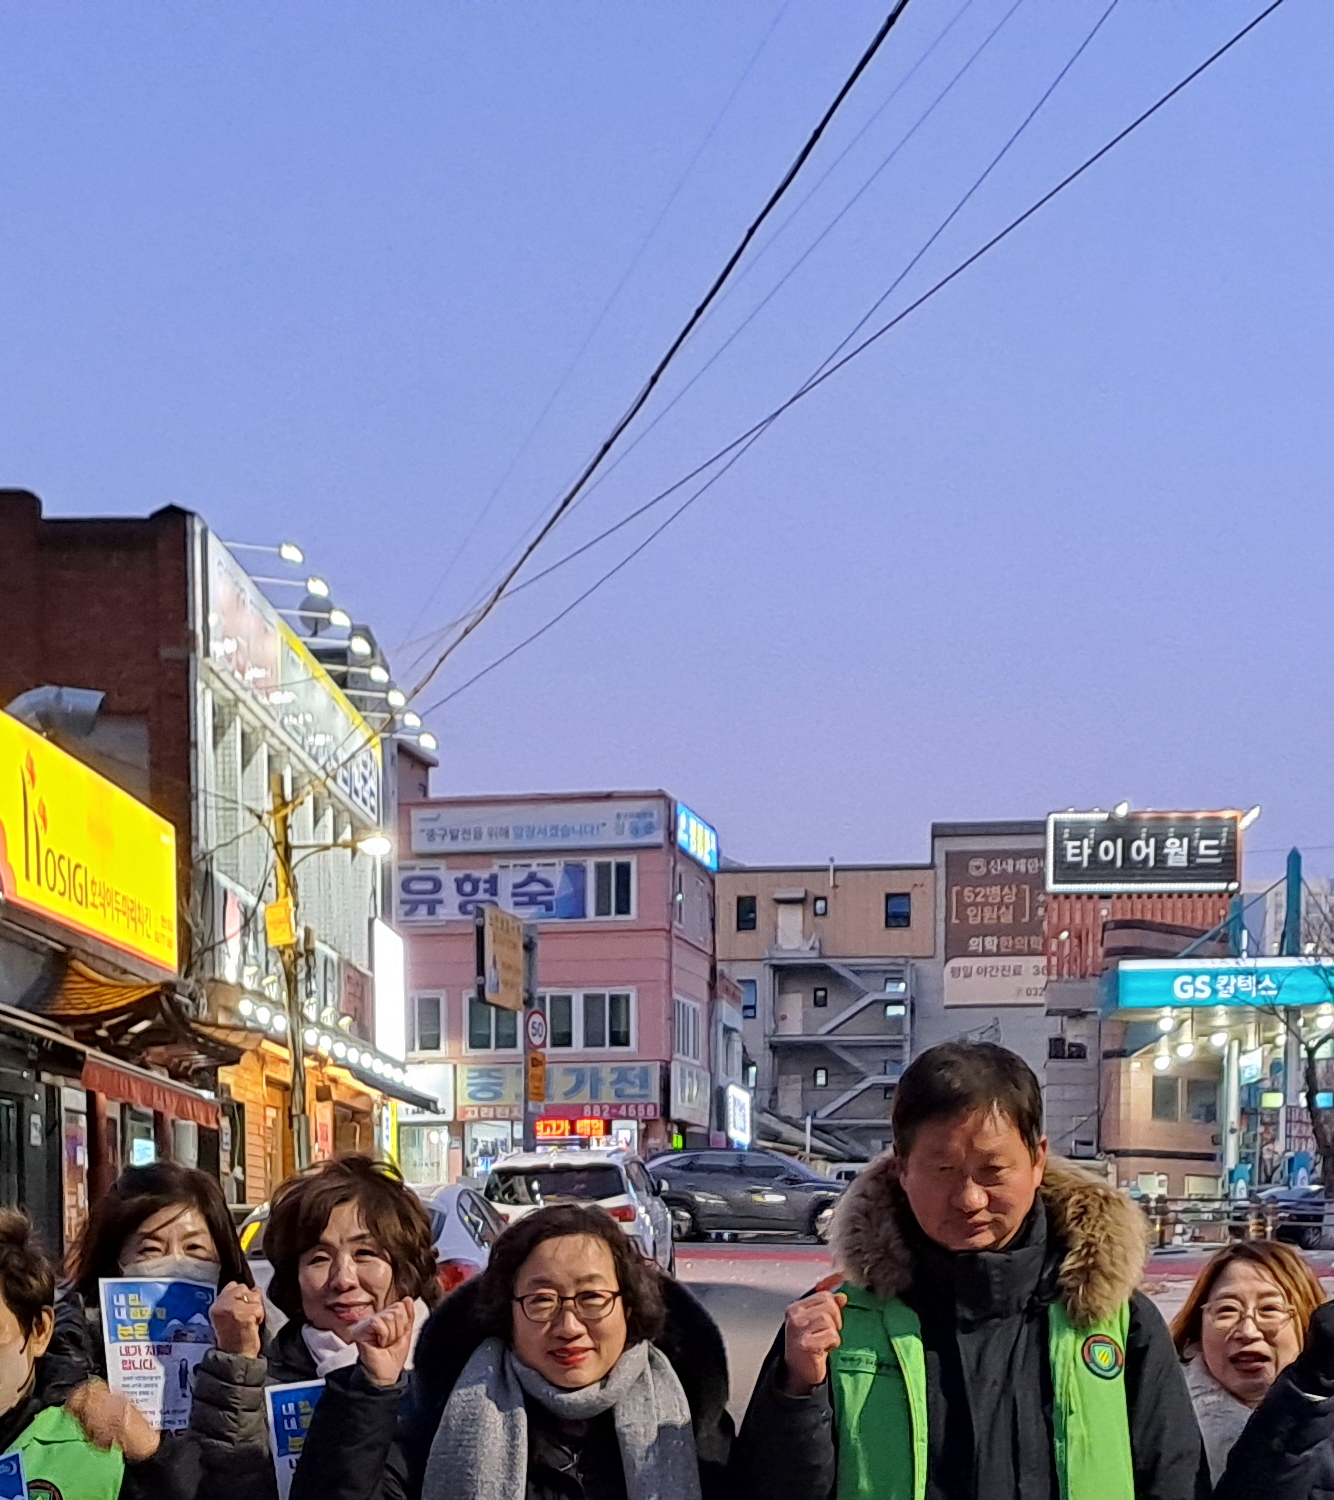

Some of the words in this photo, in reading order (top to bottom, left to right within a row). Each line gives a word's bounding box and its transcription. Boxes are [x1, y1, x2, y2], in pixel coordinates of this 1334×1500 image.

[1066, 836, 1224, 869] 타이어월드
[1173, 974, 1211, 999] GS
[1215, 973, 1278, 999] 칼텍스
[530, 1021, 544, 1038] 50
